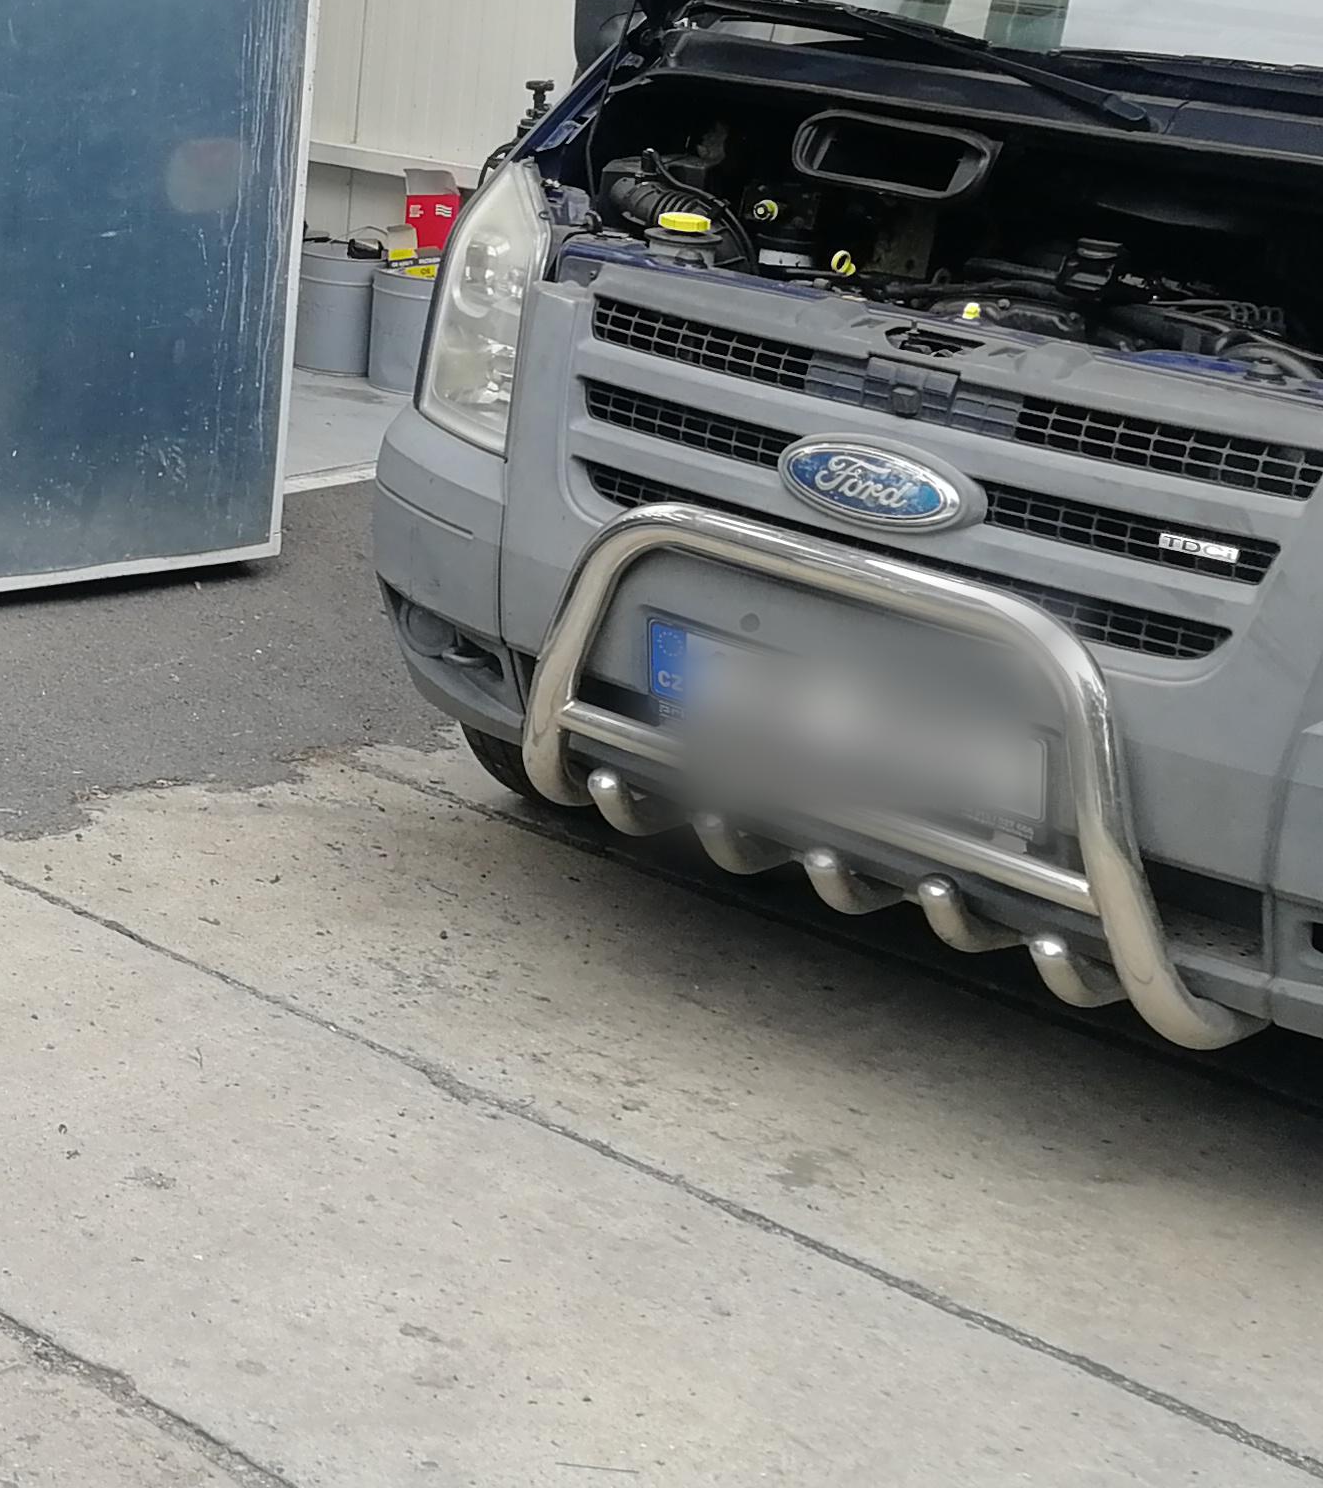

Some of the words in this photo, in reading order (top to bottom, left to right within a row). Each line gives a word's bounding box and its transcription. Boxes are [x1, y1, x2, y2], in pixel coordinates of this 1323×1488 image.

[815, 455, 912, 508] Ford
[1163, 535, 1232, 560] TDCi
[658, 670, 683, 691] CZ
